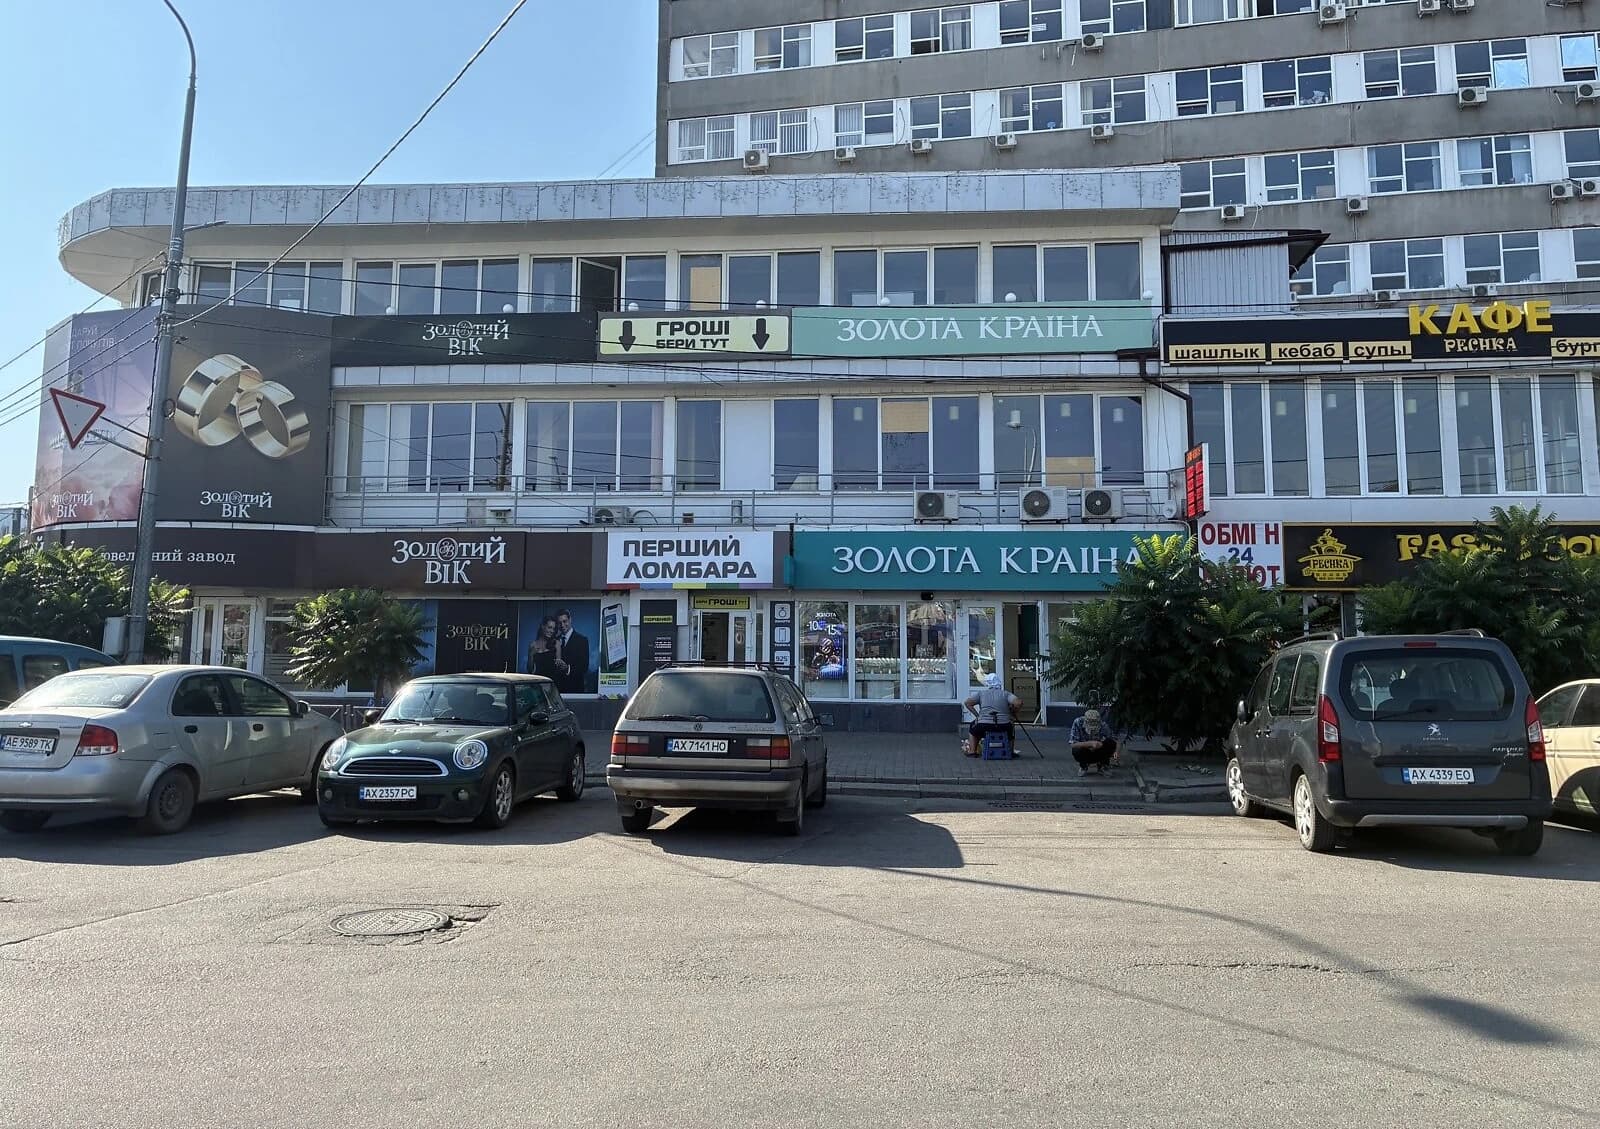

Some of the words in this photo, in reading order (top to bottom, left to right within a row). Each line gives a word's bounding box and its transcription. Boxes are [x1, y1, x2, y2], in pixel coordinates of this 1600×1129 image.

[1408, 301, 1553, 335] КАФЕ
[656, 320, 729, 336] ГРОШІ
[836, 318, 963, 341] ЗОЛОТА
[656, 339, 695, 348] БЕРИ
[700, 338, 729, 348] ТУТ
[1444, 337, 1517, 353] PECHKA
[1175, 347, 1259, 359] шашлык
[1278, 344, 1335, 357] кебаб
[1354, 345, 1407, 358] супы
[624, 535, 740, 556] ПЕРШИЙ
[187, 552, 236, 564] завод
[832, 546, 982, 574] ЗОЛОТА
[1228, 547, 1253, 564] 24
[624, 561, 756, 578] ЛОМБАРД
[673, 741, 689, 751] AX
[689, 741, 710, 752] 7141
[1411, 769, 1428, 780] AX
[1429, 769, 1453, 781] 4339
[365, 788, 378, 798] AX
[379, 788, 400, 798] 2357
